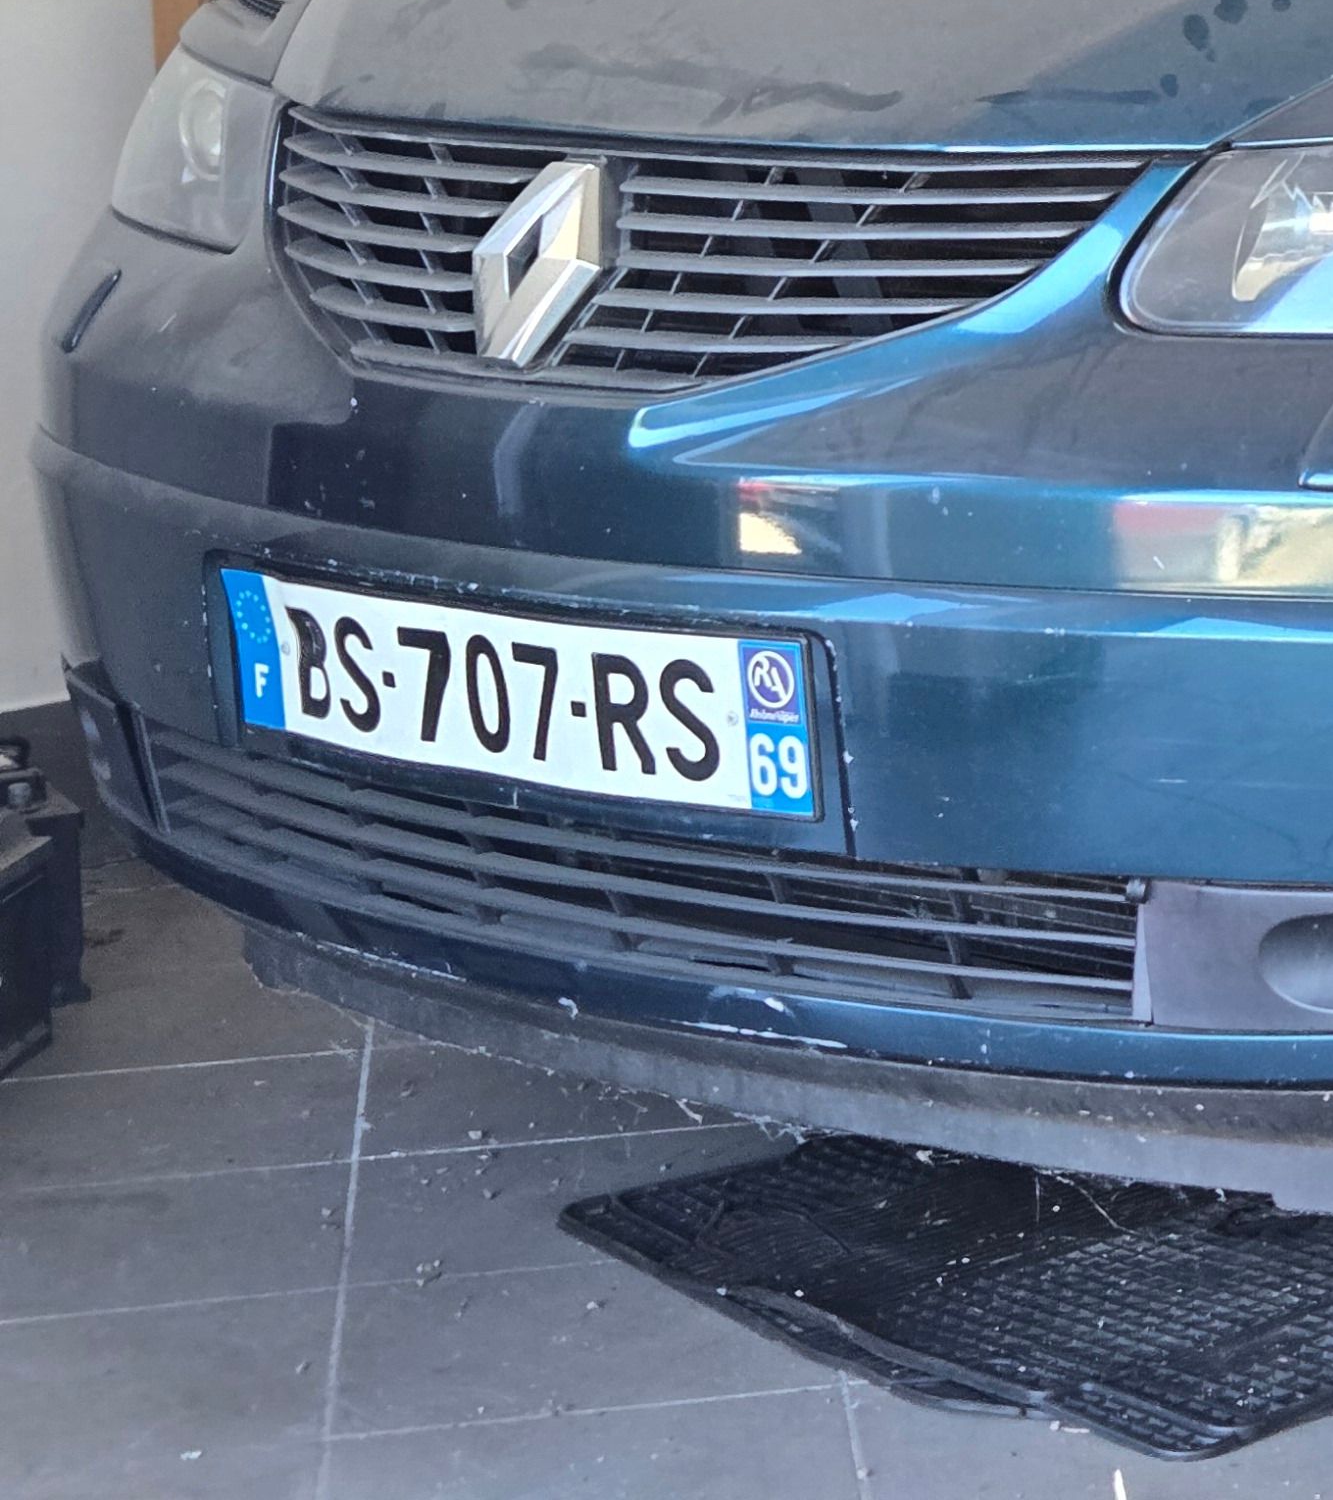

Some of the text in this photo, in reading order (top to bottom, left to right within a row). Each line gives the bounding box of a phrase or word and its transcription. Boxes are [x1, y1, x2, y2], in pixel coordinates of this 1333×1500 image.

[254, 663, 269, 699] F
[285, 606, 720, 782] BS-707-RS
[749, 732, 808, 799] 69
